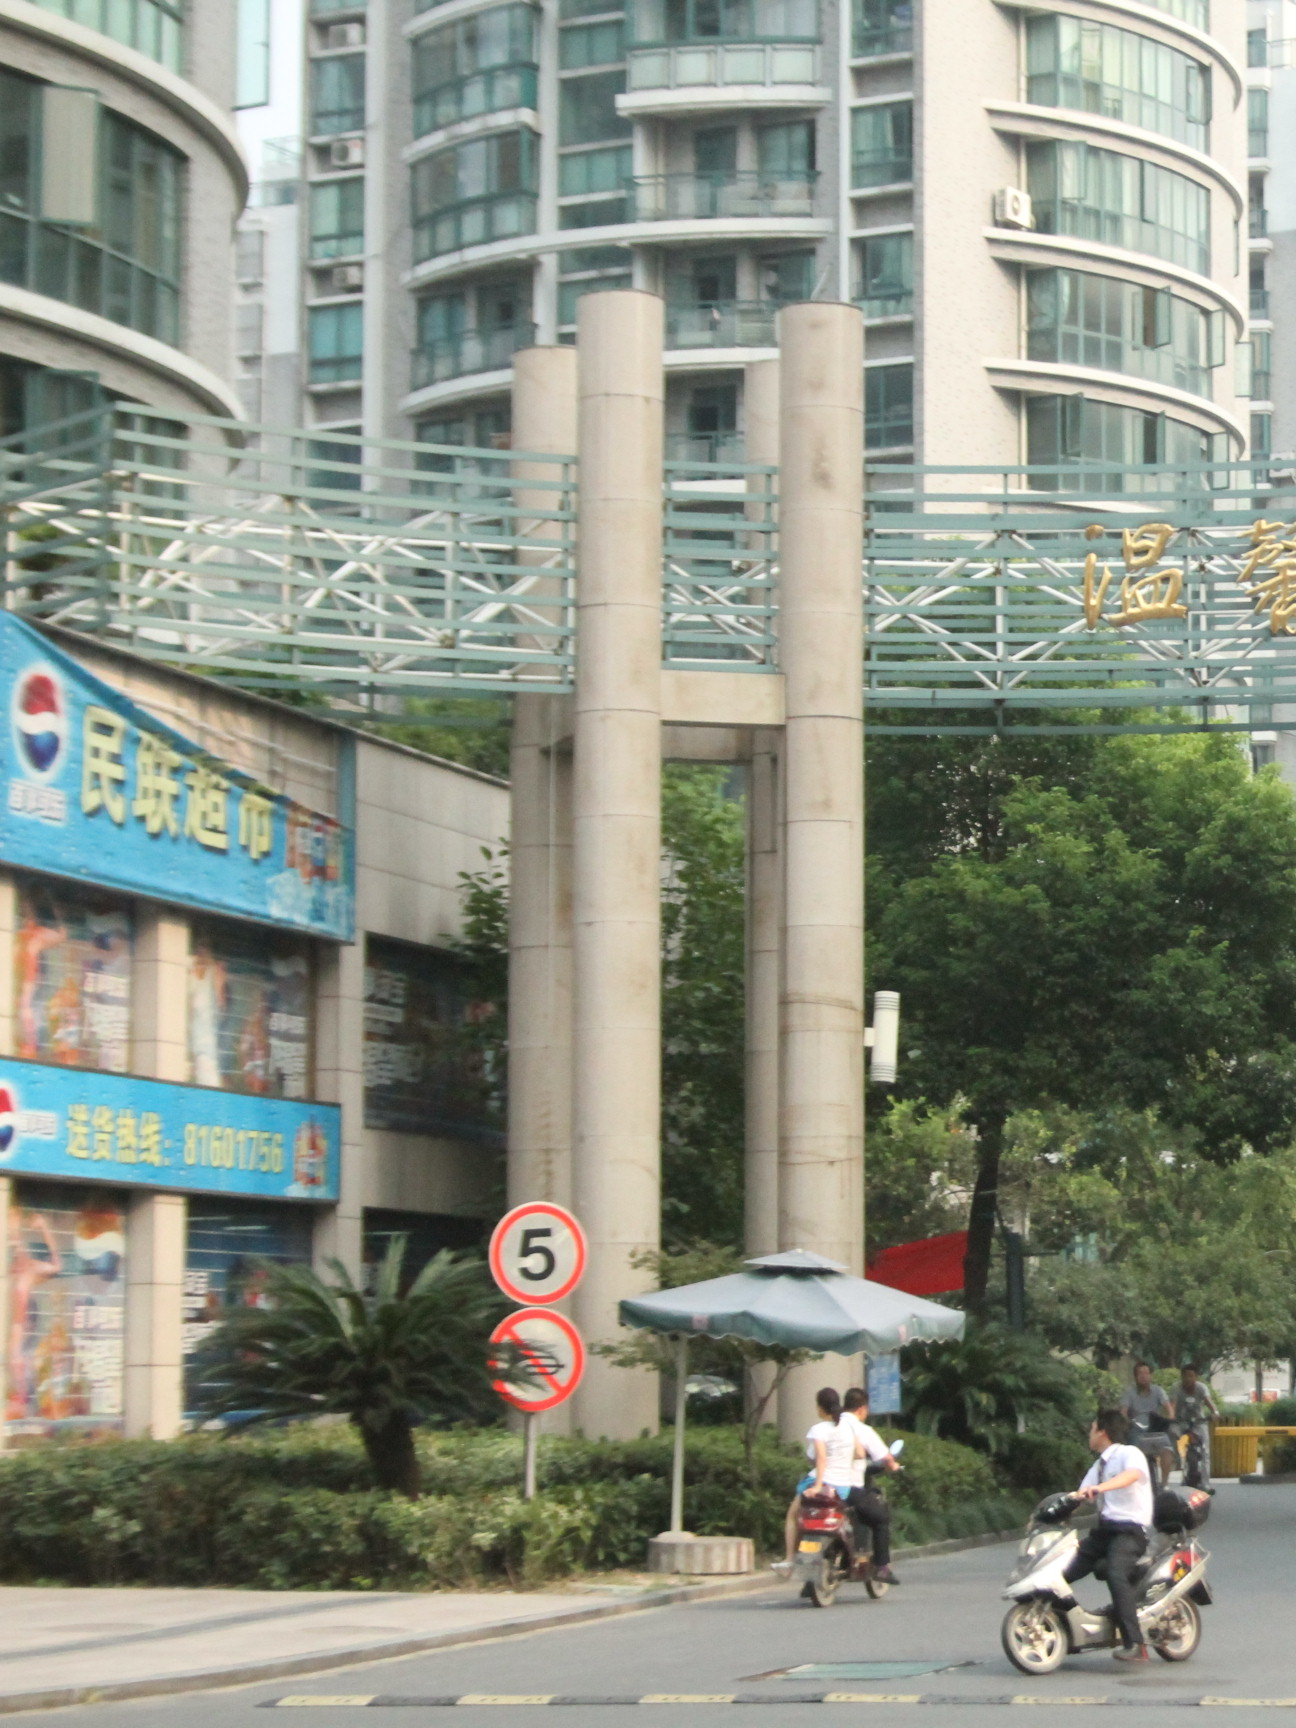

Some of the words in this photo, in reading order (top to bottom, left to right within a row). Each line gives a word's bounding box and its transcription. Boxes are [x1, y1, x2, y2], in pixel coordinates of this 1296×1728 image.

[81, 704, 273, 861] 民联超市
[184, 1122, 284, 1173] 81601756
[518, 1227, 556, 1281] 5
